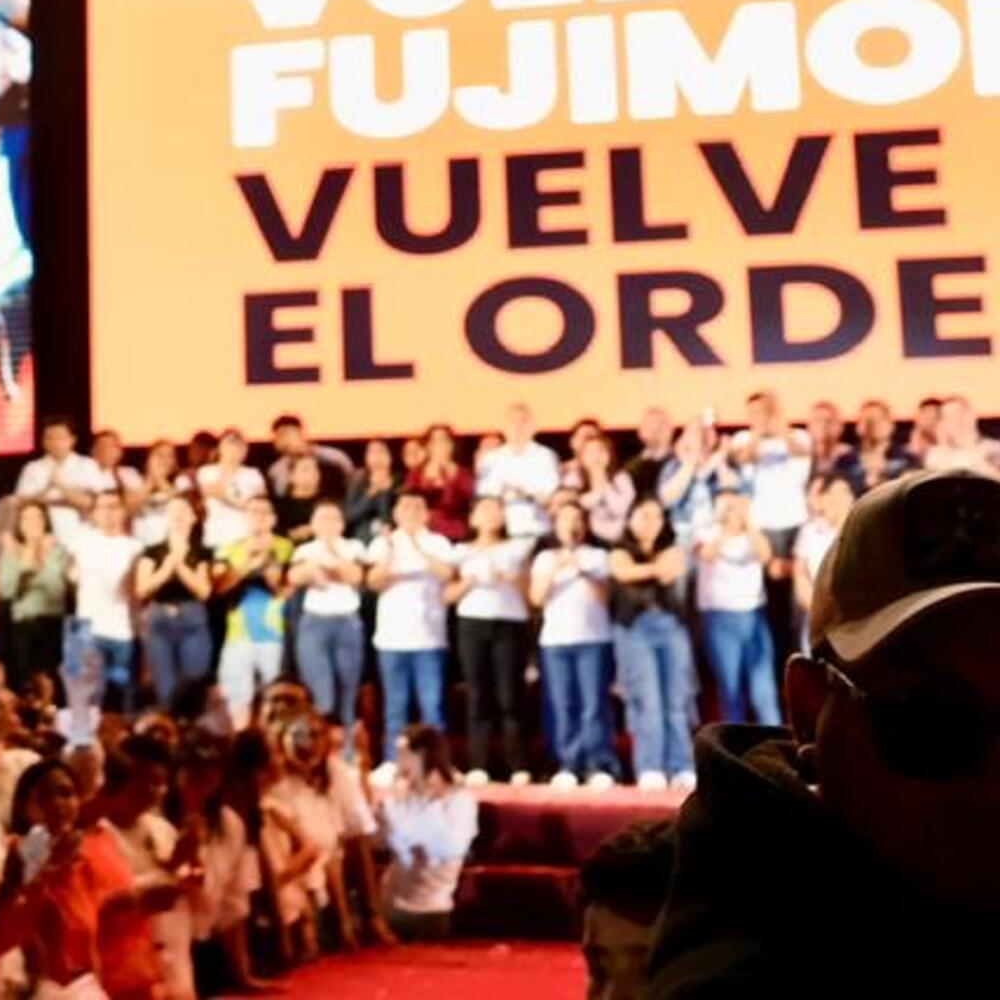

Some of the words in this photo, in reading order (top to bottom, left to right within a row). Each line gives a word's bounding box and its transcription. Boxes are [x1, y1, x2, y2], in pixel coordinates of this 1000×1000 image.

[235, 128, 947, 261] VUELVE
[243, 288, 415, 385] EL
[463, 256, 993, 374] ORDE
